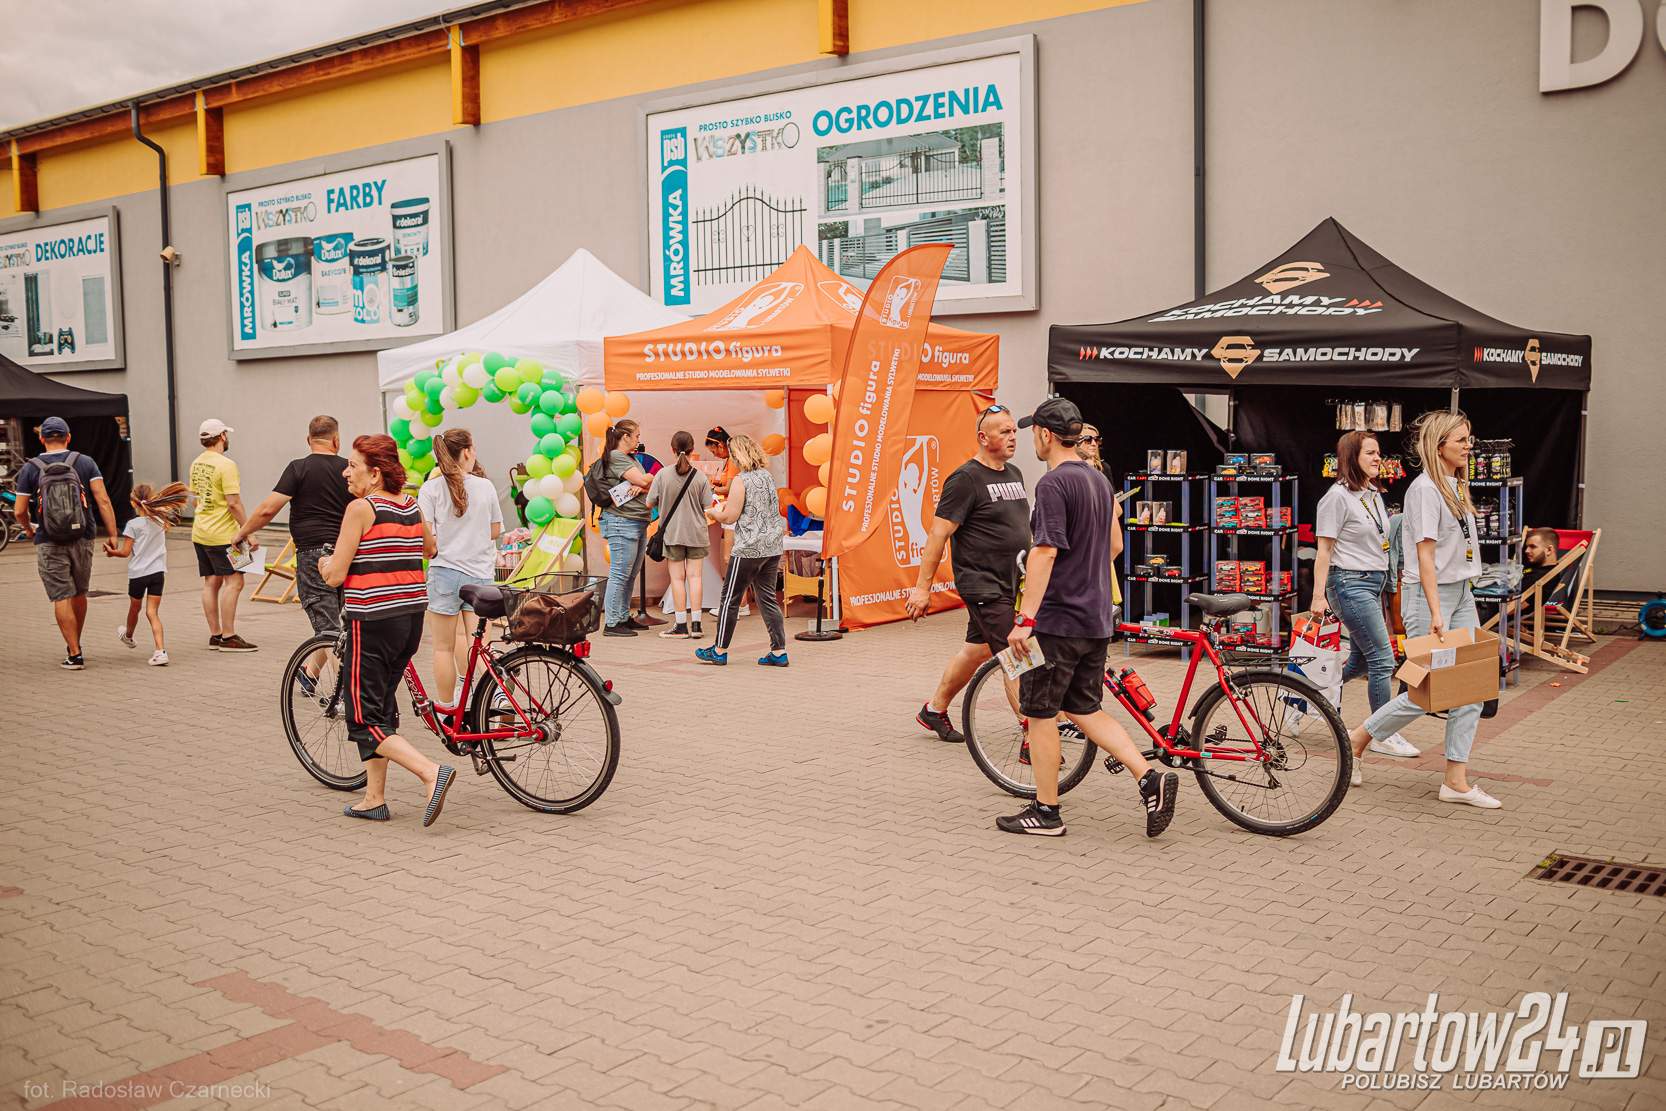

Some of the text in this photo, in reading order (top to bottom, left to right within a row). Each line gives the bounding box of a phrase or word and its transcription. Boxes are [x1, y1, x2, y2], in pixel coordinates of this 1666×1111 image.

[1540, 0, 1666, 93] D
[699, 110, 792, 132] PROSTO SZYBKO BLISKO
[812, 83, 1003, 137] OGRODZENIA
[693, 122, 800, 162] WSZYSTKO
[326, 179, 387, 214] FARBY
[35, 232, 105, 263] DEKORACJE
[665, 188, 685, 297] MRÓWKA
[240, 250, 254, 334] MRÓWKA
[1164, 295, 1347, 317] KOCHAMY
[1148, 306, 1383, 323] SAMOCHODY
[643, 340, 782, 363] STUDIO figura
[934, 345, 970, 368] figura
[1100, 346, 1421, 362] KOCHAMY SAMOCHODY
[1483, 347, 1584, 367] KOCHAMY SAMOCHODY
[636, 367, 790, 380] PROFESJONALNE STUDIO MODELOWANIA SYLWETKI
[842, 360, 880, 512] STUDIO figura
[861, 348, 901, 532] PROFESJONALNE STUDIO MODELOWANIA SYLWETKI
